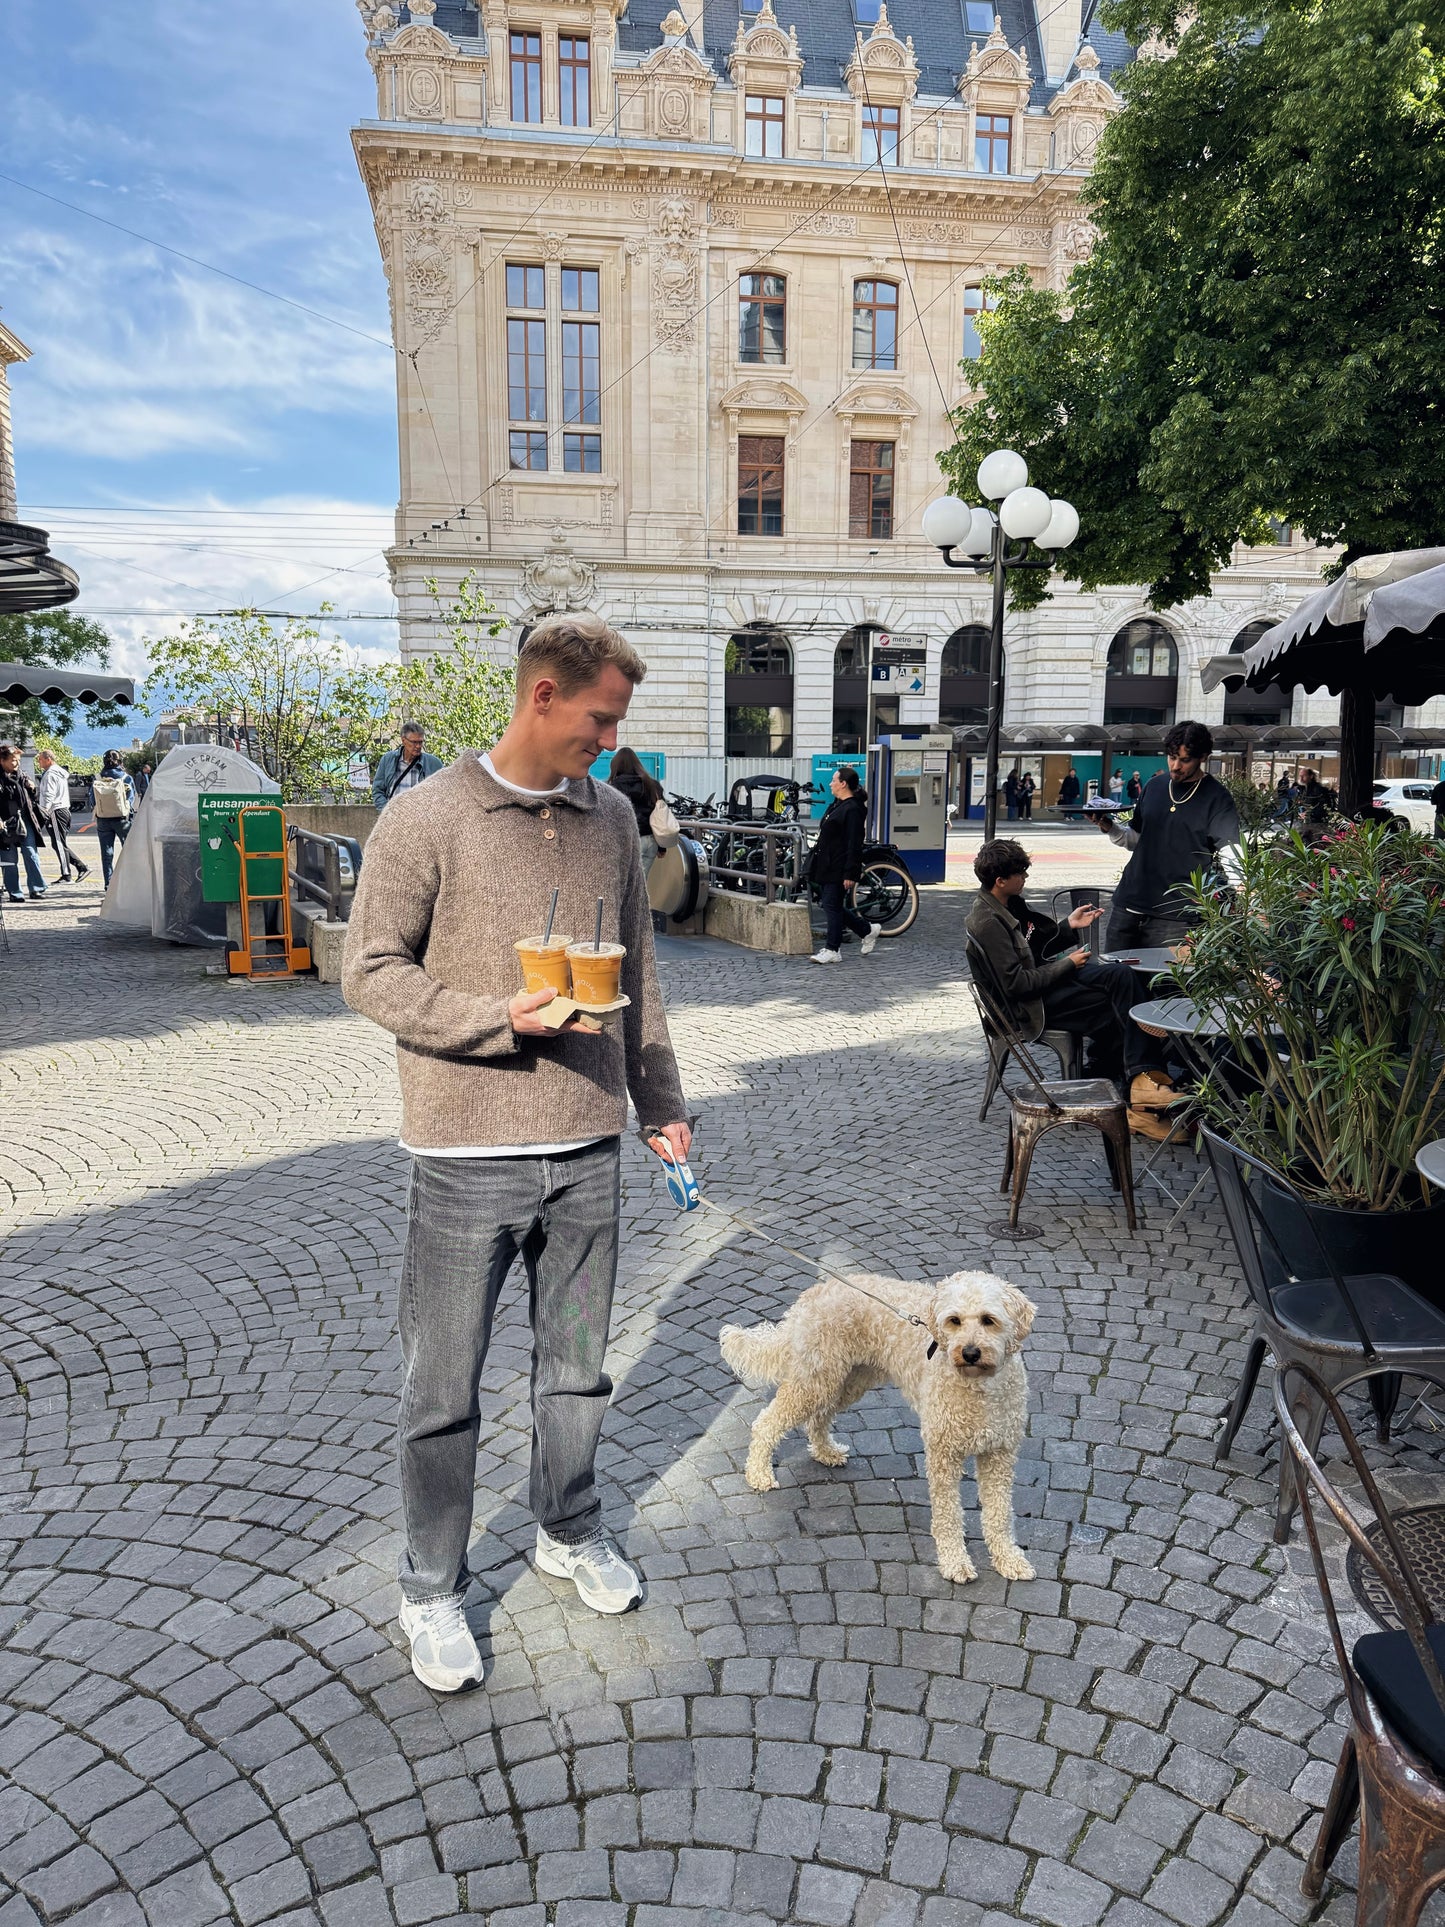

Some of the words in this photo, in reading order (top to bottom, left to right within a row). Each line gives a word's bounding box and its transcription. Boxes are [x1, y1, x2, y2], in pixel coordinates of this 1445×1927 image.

[880, 670, 887, 680] B
[184, 757, 198, 770] ICE
[200, 754, 228, 771] CREAM
